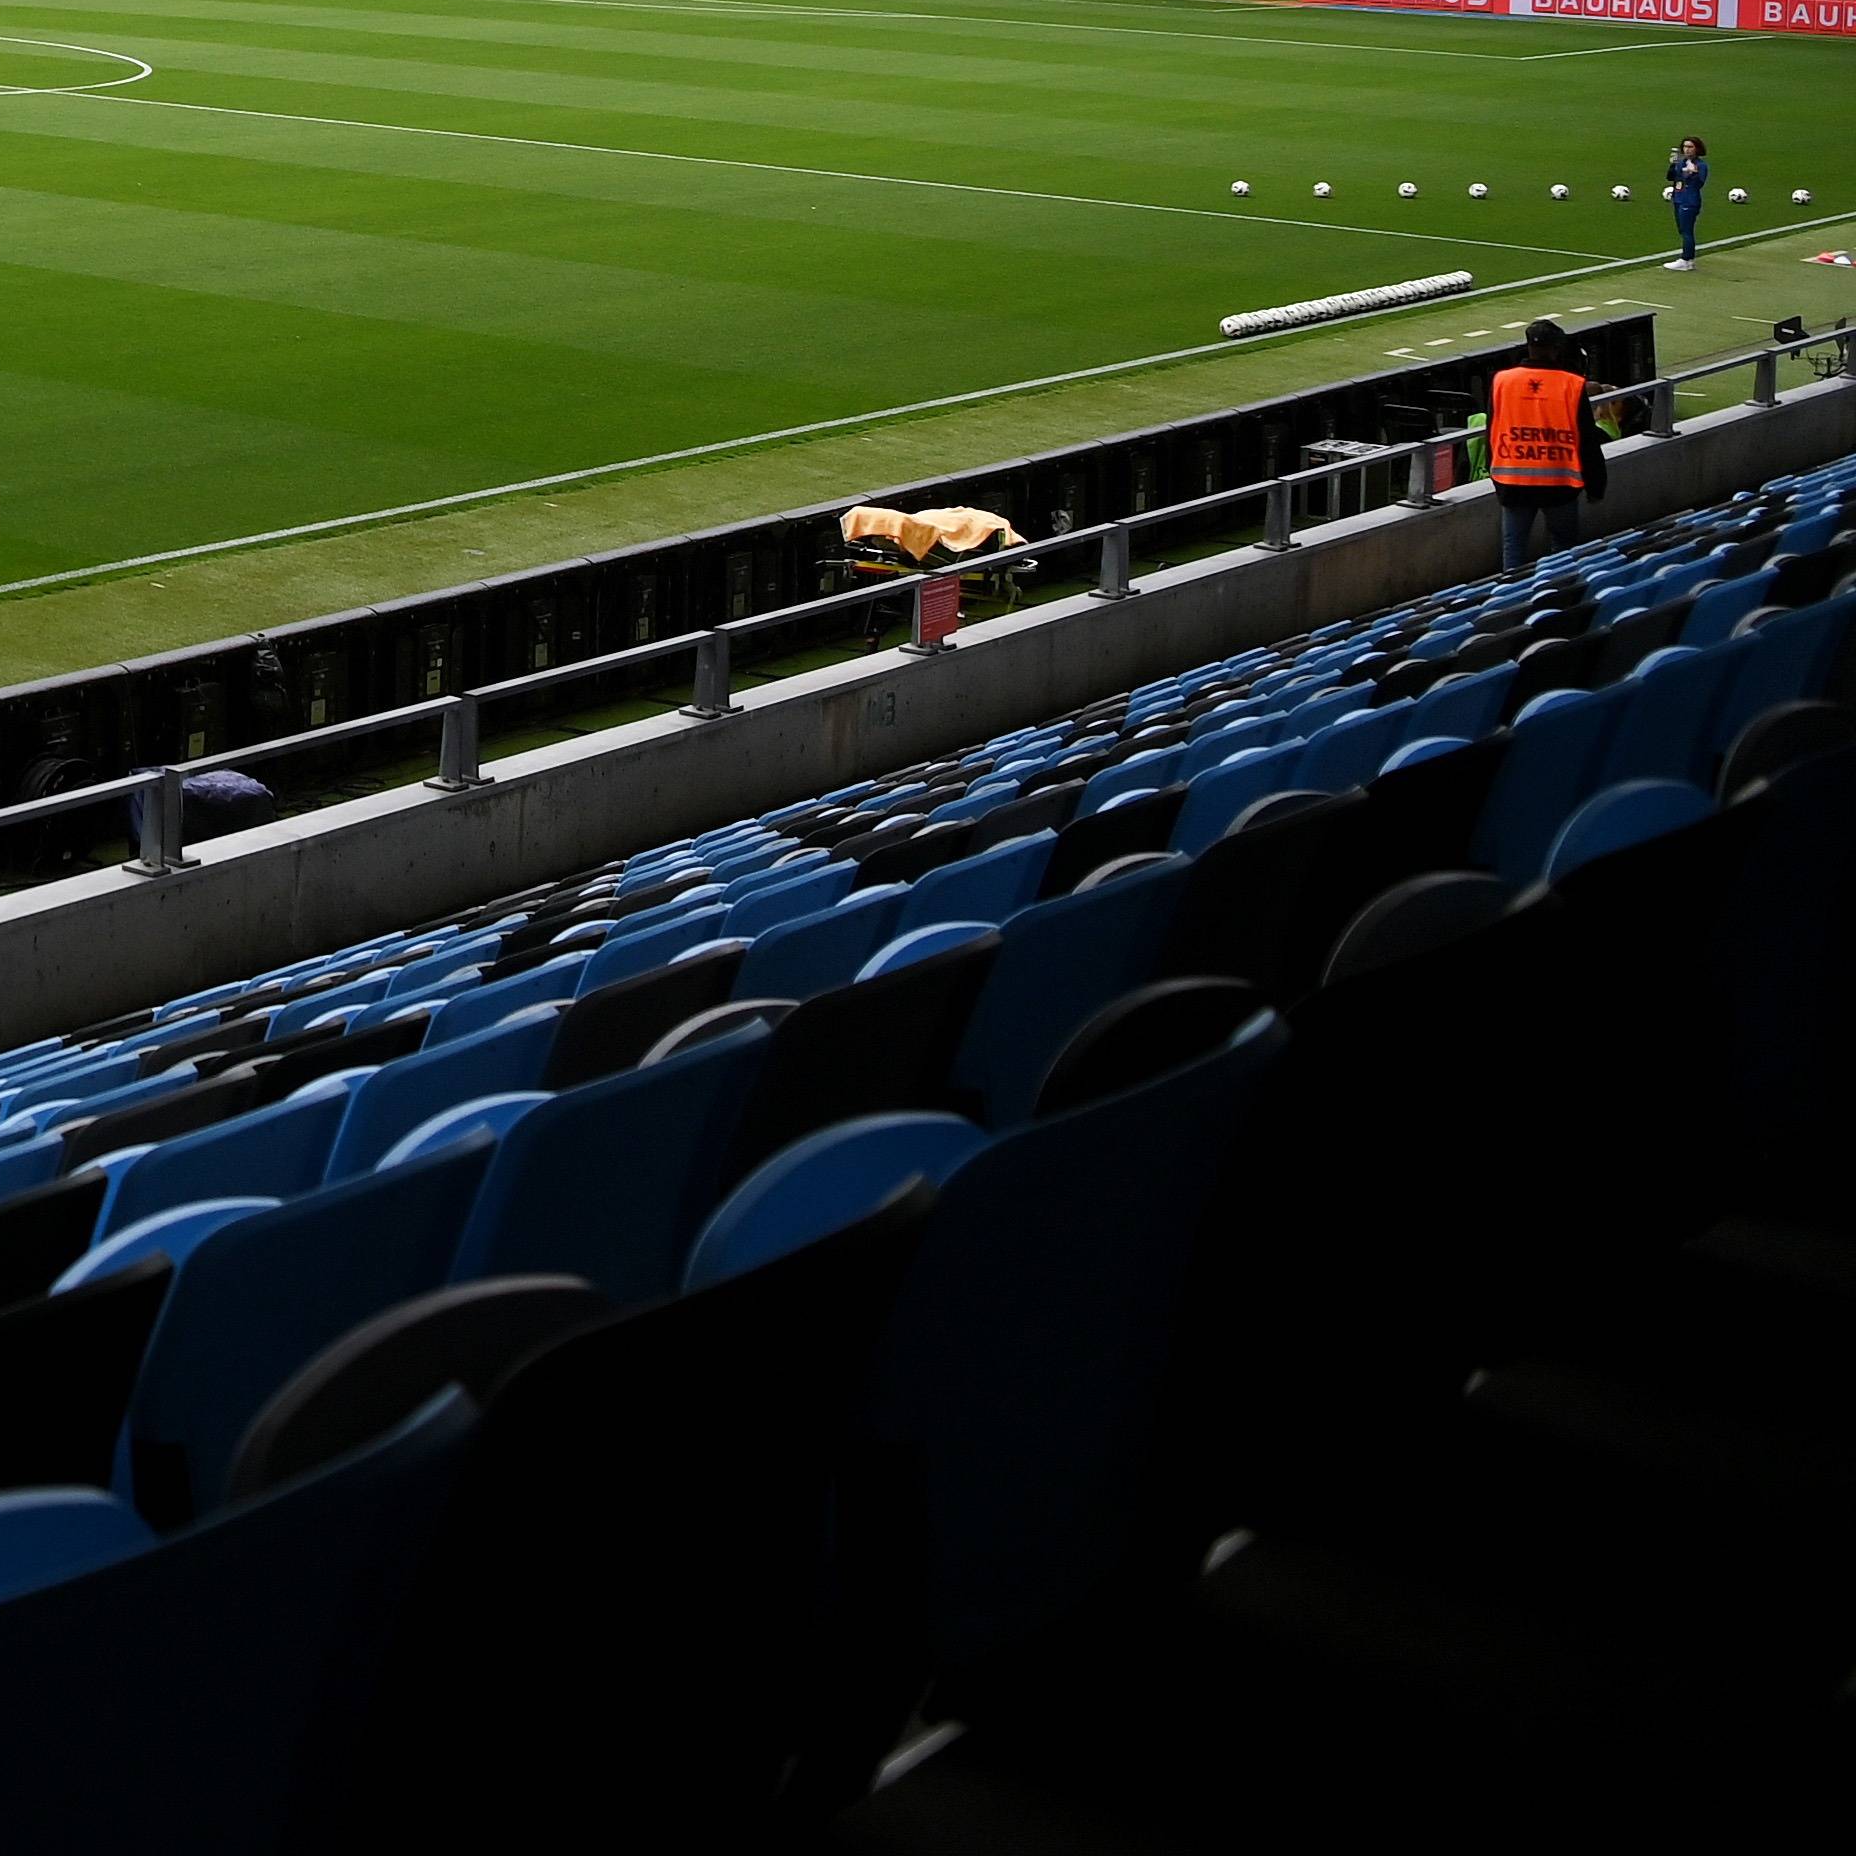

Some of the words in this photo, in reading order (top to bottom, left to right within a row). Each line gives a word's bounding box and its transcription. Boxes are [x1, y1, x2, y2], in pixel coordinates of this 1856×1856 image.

[1510, 426, 1576, 444] SERVICE
[1497, 433, 1510, 459] &
[1514, 445, 1574, 462] SAFETY
